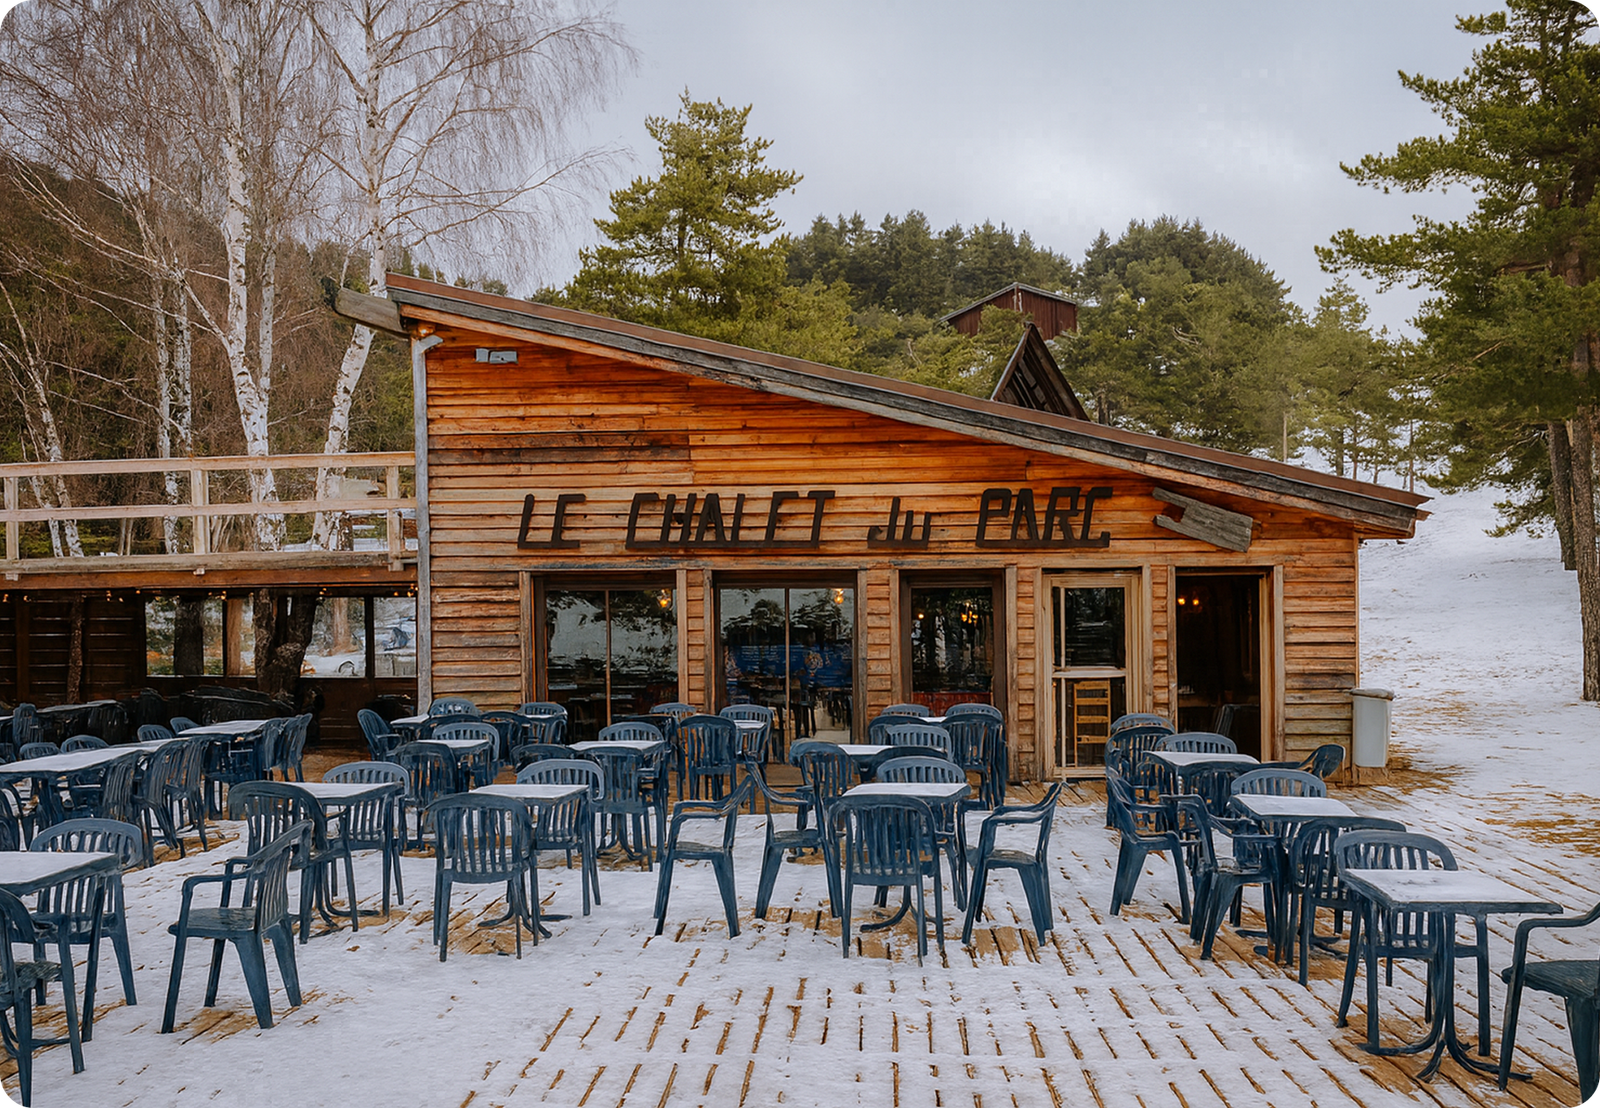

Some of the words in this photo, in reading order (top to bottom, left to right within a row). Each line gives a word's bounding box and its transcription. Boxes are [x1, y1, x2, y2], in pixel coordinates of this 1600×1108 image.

[518, 494, 586, 549] LE
[625, 491, 836, 549] CHALET
[976, 486, 1113, 548] PARC
